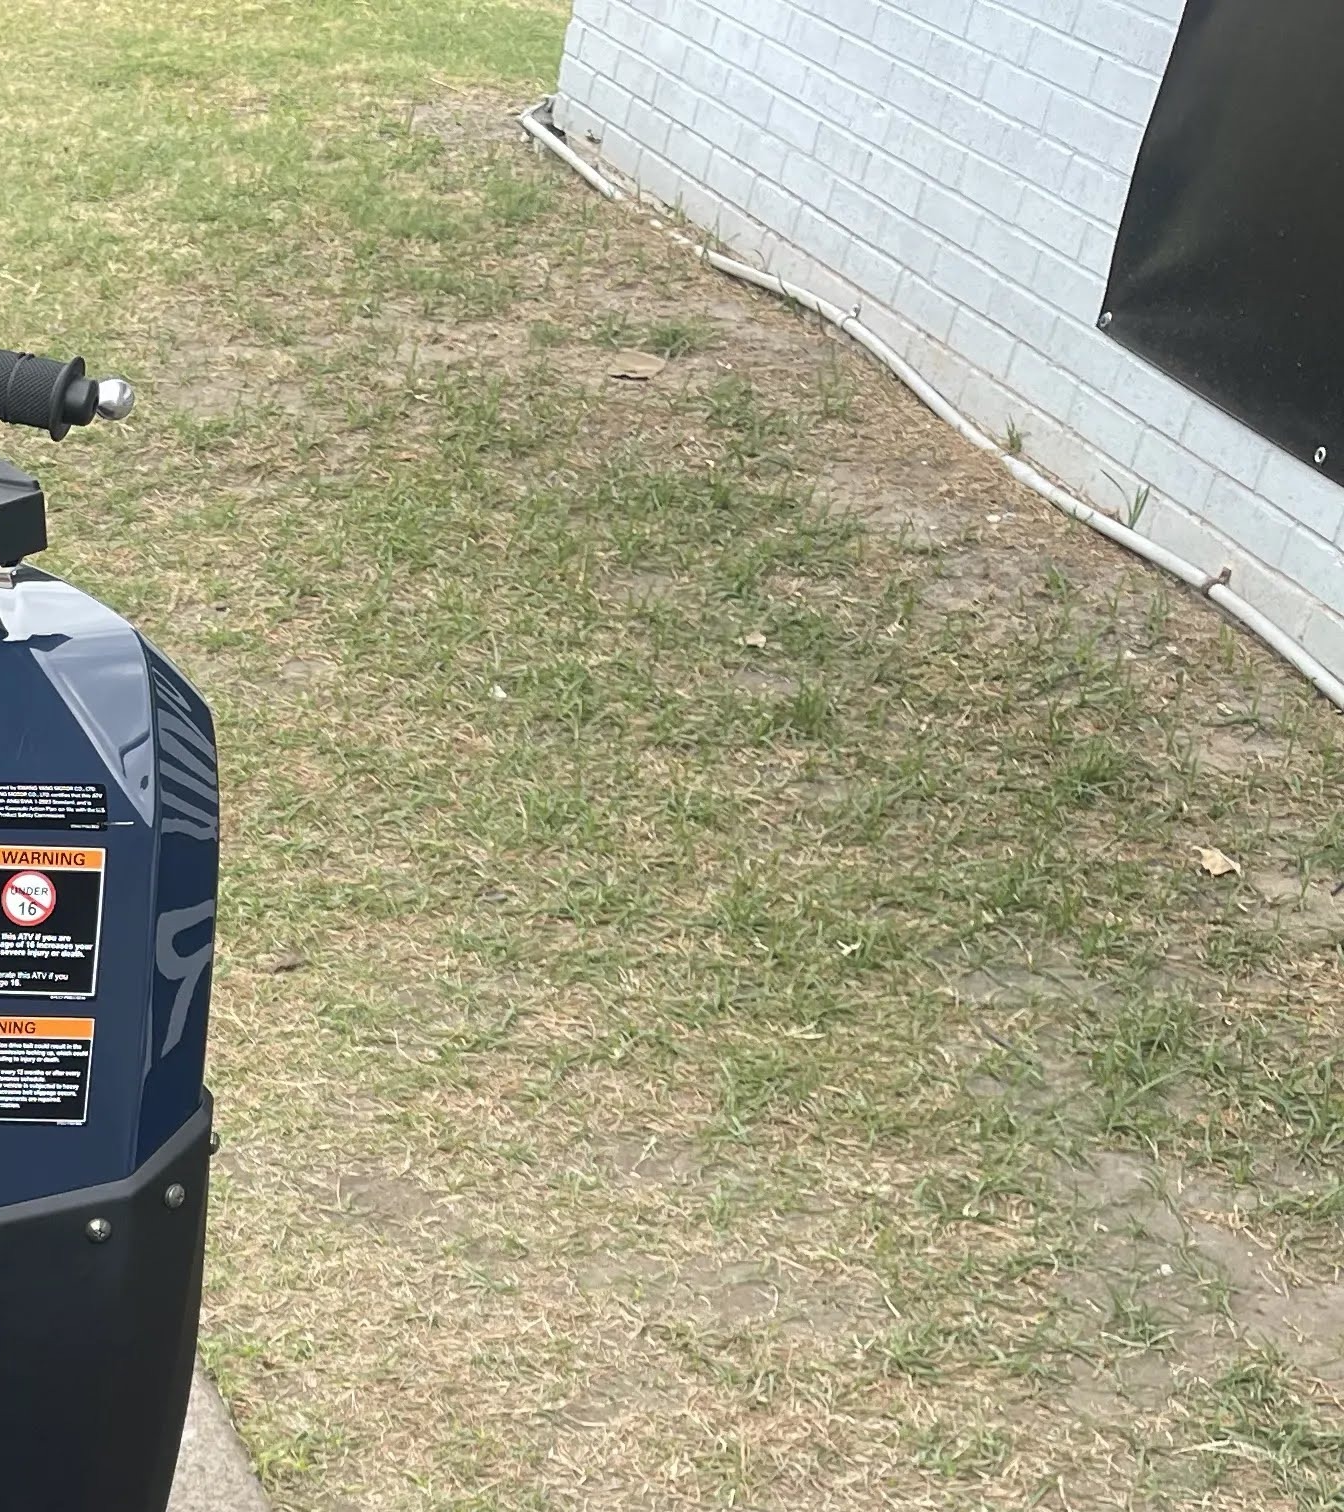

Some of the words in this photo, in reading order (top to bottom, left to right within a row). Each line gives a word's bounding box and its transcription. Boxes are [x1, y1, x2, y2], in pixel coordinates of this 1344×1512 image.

[2, 851, 86, 866] WARNING
[11, 886, 48, 896] UNDER
[18, 902, 37, 916] 16
[27, 949, 50, 958] injury
